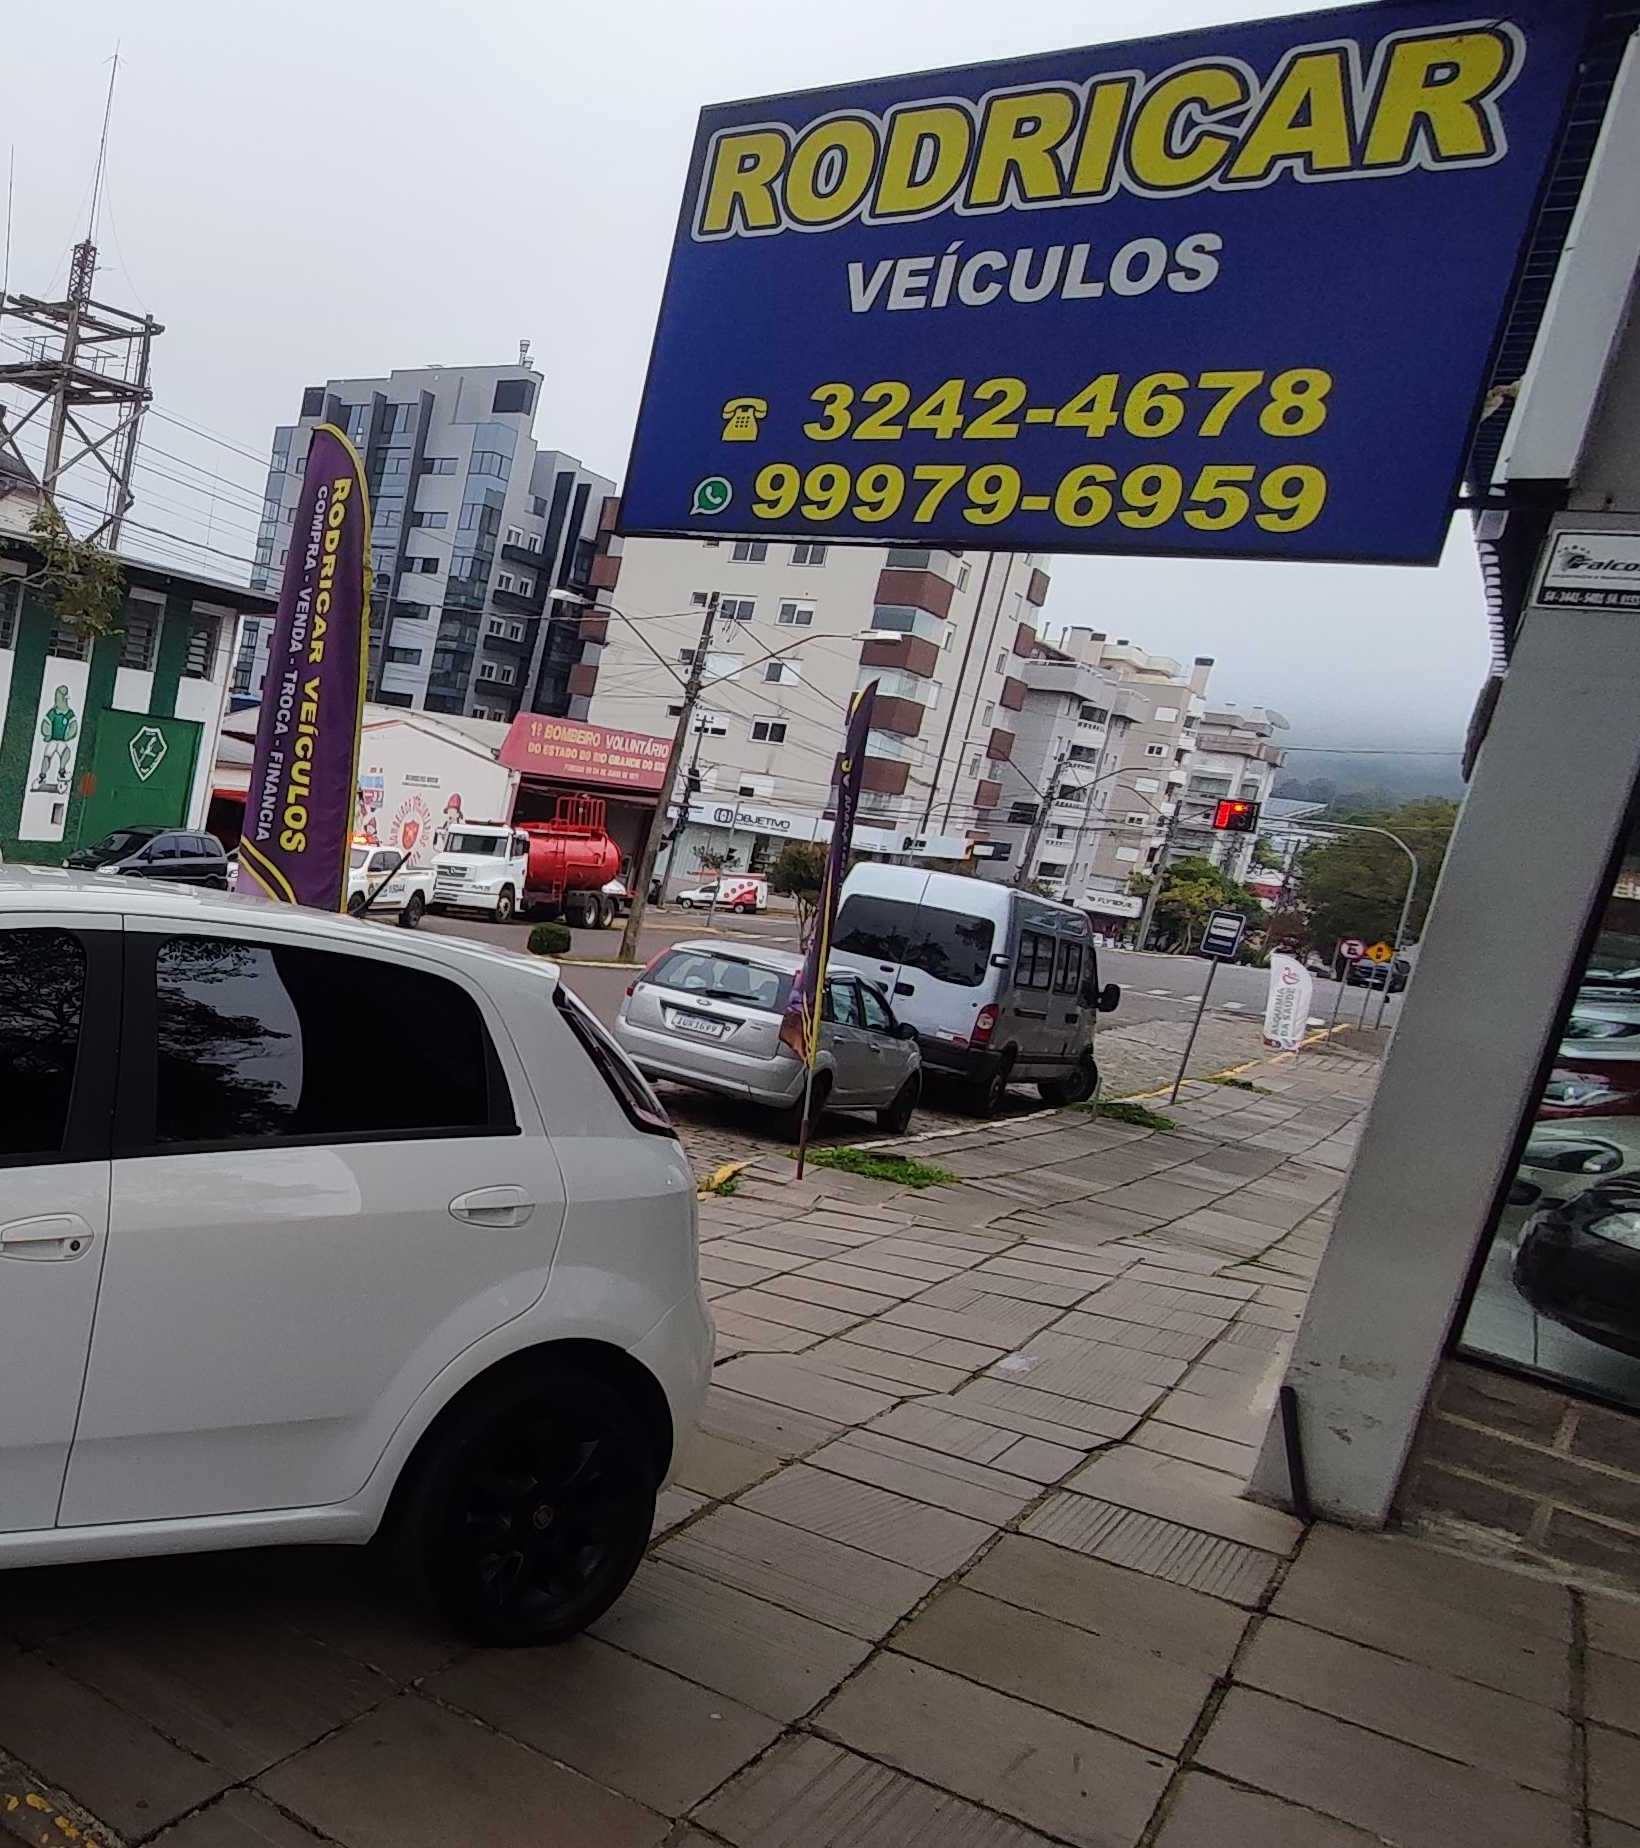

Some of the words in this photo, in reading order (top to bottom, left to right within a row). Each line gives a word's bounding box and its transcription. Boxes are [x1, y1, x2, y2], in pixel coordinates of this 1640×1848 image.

[693, 20, 1526, 242] RODRICAR
[847, 232, 1223, 312] VEÍCULOS
[803, 367, 1333, 441] 3242-4678
[304, 485, 329, 571] COMPRA
[751, 463, 1328, 533] 99979-6959
[309, 478, 352, 664] RODRICAR
[1567, 555, 1640, 571] Falco
[289, 587, 313, 653] VENDA
[274, 670, 298, 735] TROCA
[280, 676, 321, 853] VEÍCULOS
[528, 742, 542, 753] DO
[543, 744, 578, 758] ESTADO
[544, 724, 601, 748] BOMBEIRO
[606, 736, 670, 759] VOLUNTÁRIO
[256, 751, 284, 841] FINANCIA
[735, 813, 791, 829] OBJETIVO
[1271, 987, 1285, 1036] ALQUIMIA
